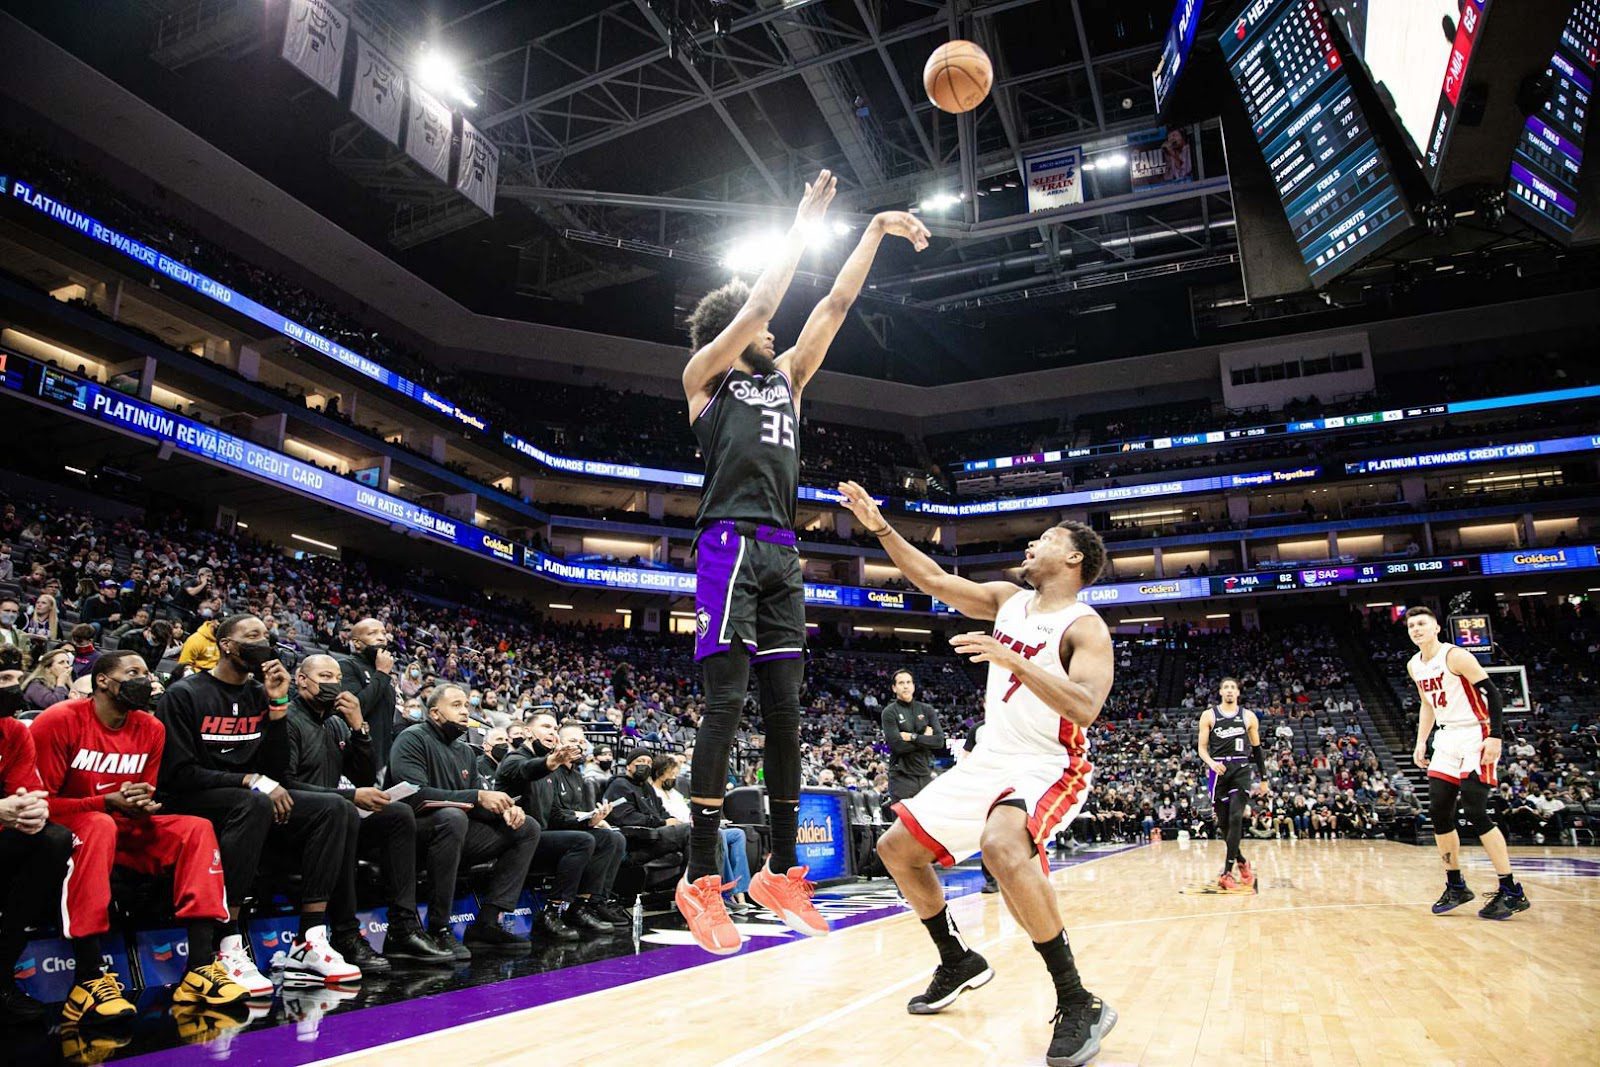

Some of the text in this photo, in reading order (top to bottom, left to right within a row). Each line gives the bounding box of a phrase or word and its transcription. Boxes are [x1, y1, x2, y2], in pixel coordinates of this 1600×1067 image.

[1463, 6, 1477, 34] 62
[1239, 40, 1265, 70] IN-GAME
[1450, 50, 1464, 80] MIA
[1287, 104, 1322, 138] SHOOTING
[1131, 148, 1166, 171] PAUL
[1032, 173, 1066, 186] SLEEP
[1042, 178, 1074, 192] TRAIN
[1304, 201, 1321, 216] TEAM
[1356, 157, 1378, 176] BONUS
[1317, 170, 1340, 192] FOULS
[1328, 210, 1366, 241] TIMEOUTS
[13, 182, 231, 303] PLATINUM REWARDS CREDIT CARD
[284, 321, 304, 342] LOW
[304, 331, 330, 352] RATES
[339, 349, 360, 367] CASH
[360, 360, 381, 378] BACK
[422, 392, 486, 430] Stronger Together
[93, 394, 323, 490] PLATINUM REWARDS CREDIT CARD
[760, 410, 795, 450] 35
[517, 439, 546, 462] PLATINUM
[546, 454, 584, 471] REWARDS
[585, 460, 616, 476] CREDIT
[617, 465, 640, 478] CARD
[1022, 455, 1036, 464] LAL
[1131, 442, 1146, 450] PHX
[1183, 436, 1200, 444] CHA
[1368, 444, 1534, 471] PLATINUM REWARDS CREDIT CARD
[922, 468, 1318, 515] PLATINUM REWARDS CREDIT CARD LOW RATES CASH BACK Stronger Together
[356, 490, 376, 506] LOW
[378, 497, 404, 518] RATES
[414, 512, 435, 528] CASH
[436, 520, 456, 536] BACK
[483, 536, 514, 556] Golden1
[1514, 550, 1566, 564] Golden1
[544, 558, 676, 588] PLATINUM REWARDS CREDIT
[1241, 576, 1260, 586] MIA
[1318, 570, 1339, 579] SAC
[1387, 564, 1409, 574] 3RD
[1414, 560, 1442, 572] 10:30
[816, 588, 838, 600] BACK
[868, 592, 904, 604] Golden1
[1092, 590, 1118, 602] CARD
[1139, 583, 1180, 595] Golden1
[1458, 618, 1486, 628] 10:30
[1002, 672, 1022, 704] 7
[1432, 692, 1448, 708] 14
[200, 710, 269, 735] HEAT
[71, 748, 148, 774] MIAMI
[796, 816, 834, 844] olden1
